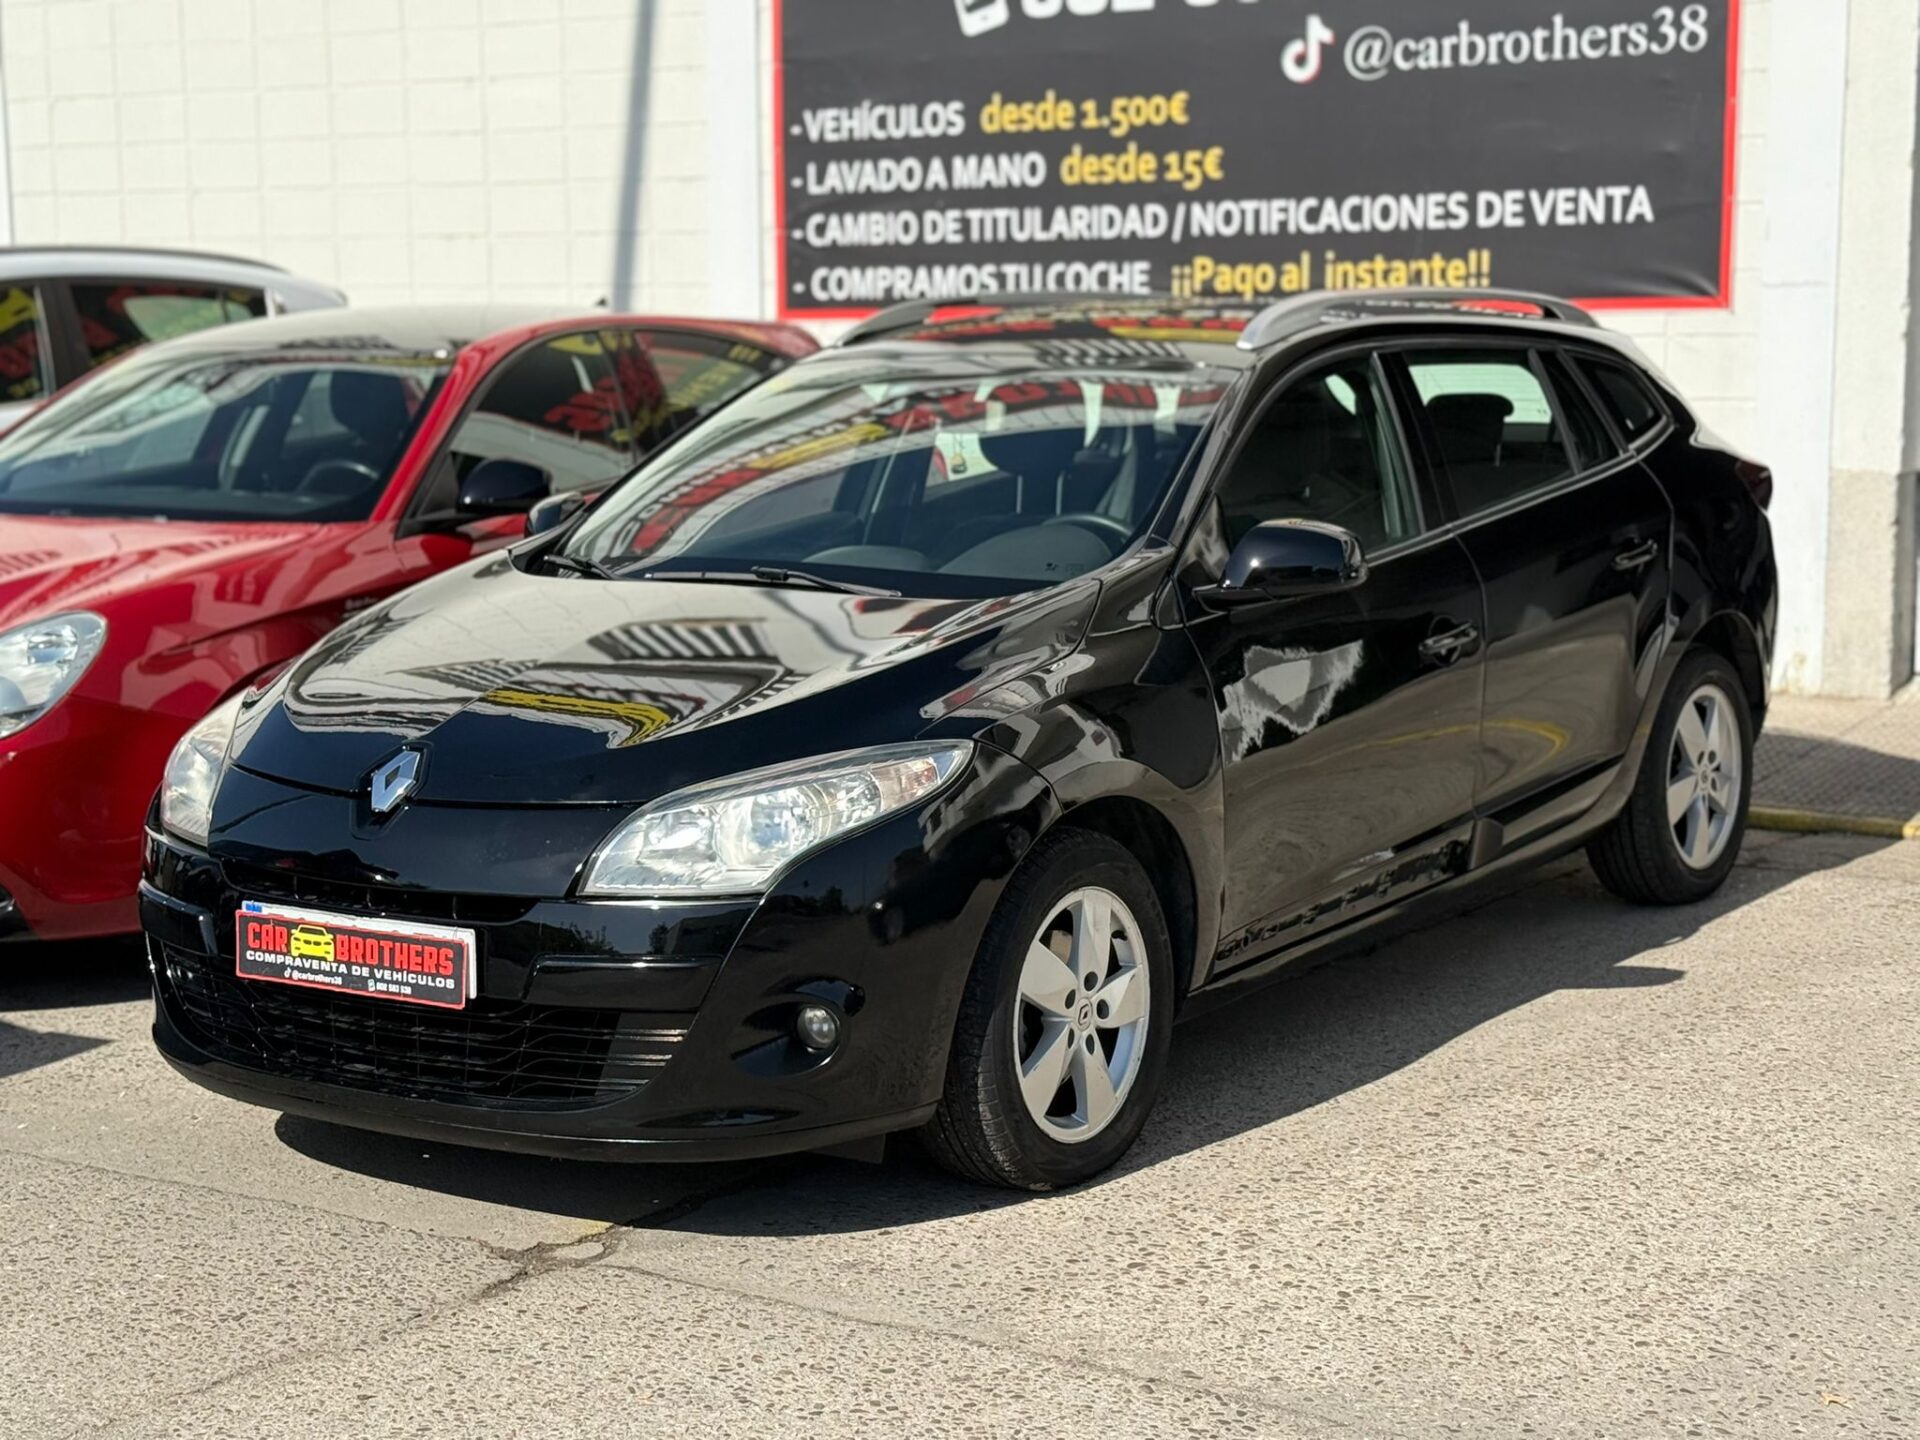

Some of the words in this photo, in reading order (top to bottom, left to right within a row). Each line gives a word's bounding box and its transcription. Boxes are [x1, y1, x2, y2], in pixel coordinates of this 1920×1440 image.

[1344, 4, 1708, 81] @carbrothers38
[980, 90, 1074, 134] desde
[1081, 91, 1189, 137] 1.500€
[924, 155, 948, 190] A
[952, 152, 1046, 189] MANO
[1060, 143, 1156, 186] desde
[1163, 146, 1224, 190] 15€
[923, 210, 964, 244] DE
[965, 203, 1168, 243] TITULARIDAD
[1172, 202, 1185, 243] /
[1190, 193, 1468, 237] NOTIFICACIONES
[1476, 191, 1525, 228] DE
[1529, 185, 1653, 226] VENTA
[999, 262, 1042, 295] TU
[1046, 261, 1151, 295] COCHE
[1281, 250, 1310, 291] al
[1325, 249, 1490, 289] instante!!
[246, 950, 348, 975] COMPRAVENTA
[351, 965, 370, 977] DE
[374, 968, 455, 989] VEHÍCULOS
[247, 922, 287, 952] CAR
[335, 934, 453, 976] BROTHERS
